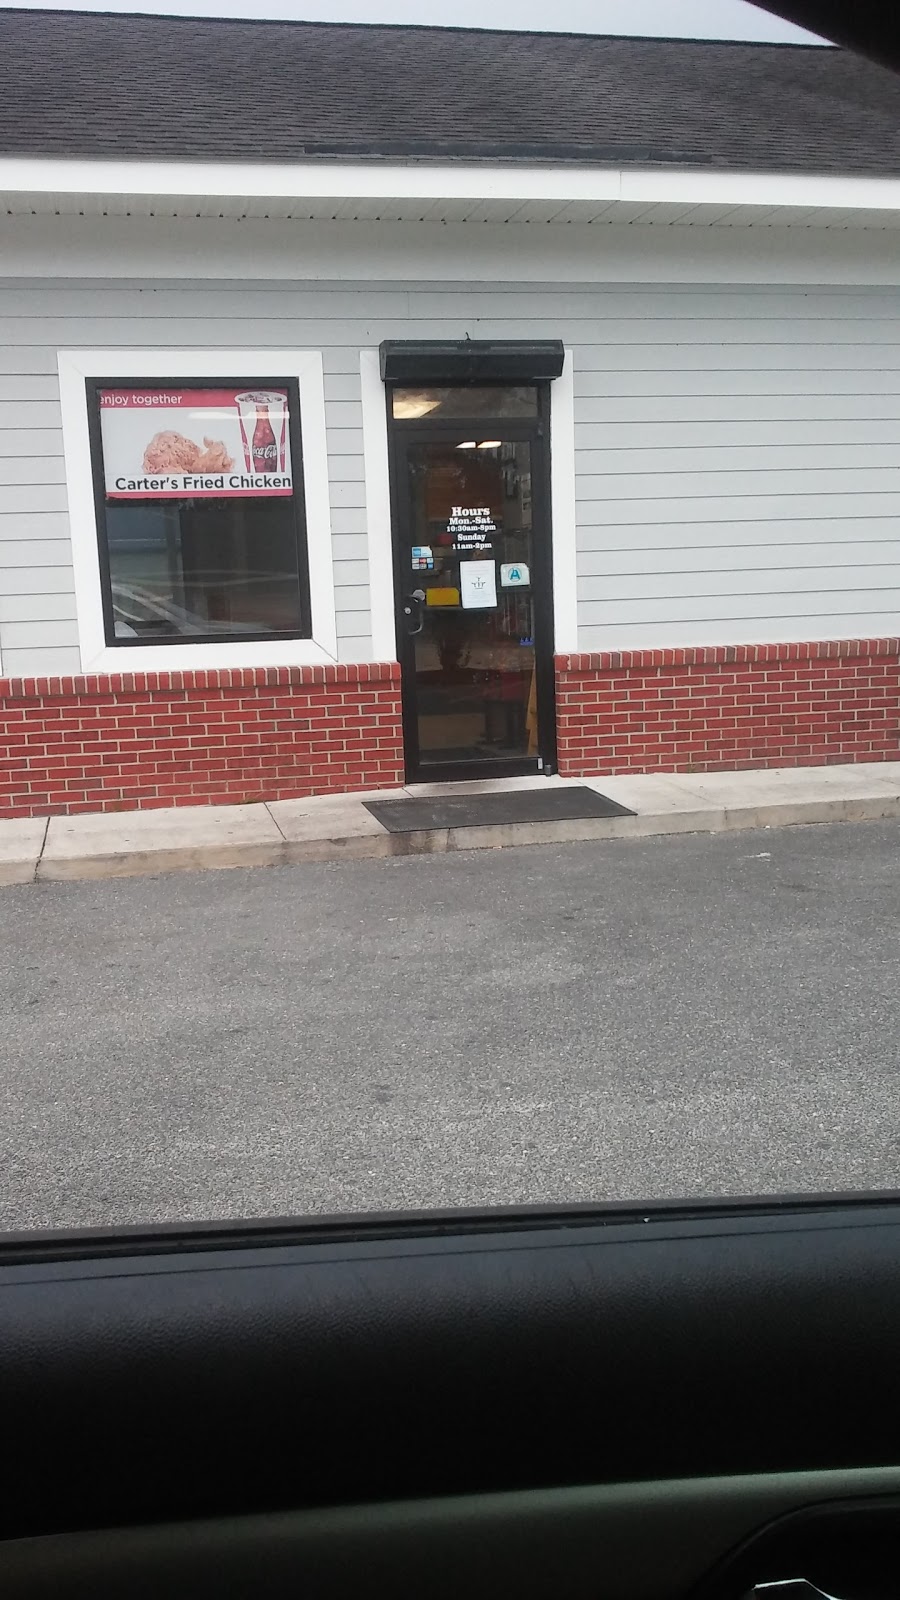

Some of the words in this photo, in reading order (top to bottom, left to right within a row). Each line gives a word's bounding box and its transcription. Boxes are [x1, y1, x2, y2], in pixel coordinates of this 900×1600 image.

[132, 394, 182, 406] together
[115, 477, 179, 491] Carter's
[183, 475, 224, 489] Fried
[229, 474, 291, 489] Chicken
[451, 506, 490, 517] Hours
[449, 517, 493, 525] Mon.-Sat.
[457, 533, 486, 542] Sunday
[509, 569, 520, 580] A
